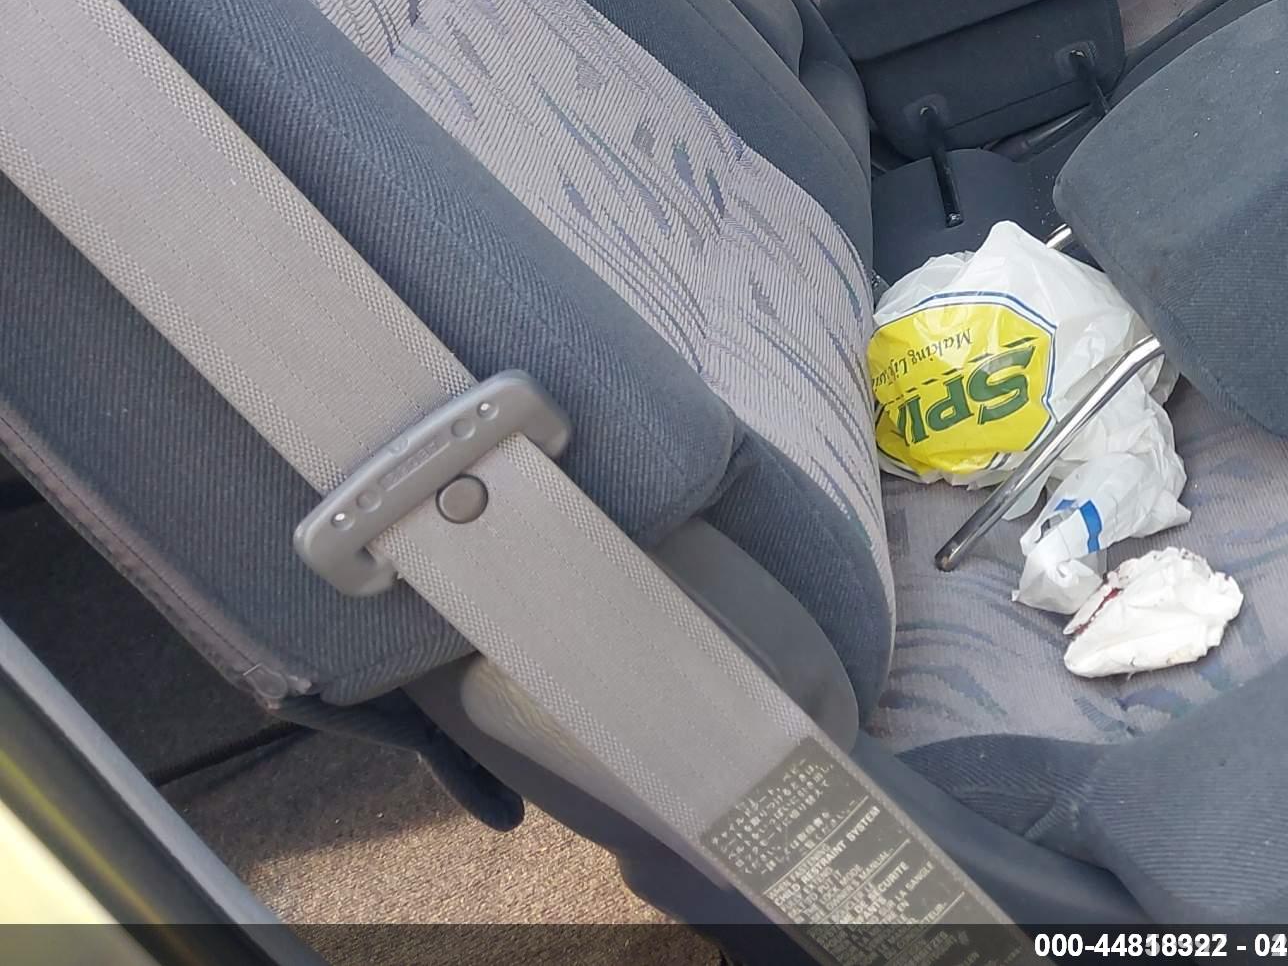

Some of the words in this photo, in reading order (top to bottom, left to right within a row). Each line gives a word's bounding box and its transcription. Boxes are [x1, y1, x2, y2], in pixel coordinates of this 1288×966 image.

[907, 327, 973, 365] Making
[772, 880, 802, 908] CHILD
[798, 838, 848, 885] RESTRAINT
[844, 804, 882, 843] SYSTEM
[837, 862, 863, 887] MODE
